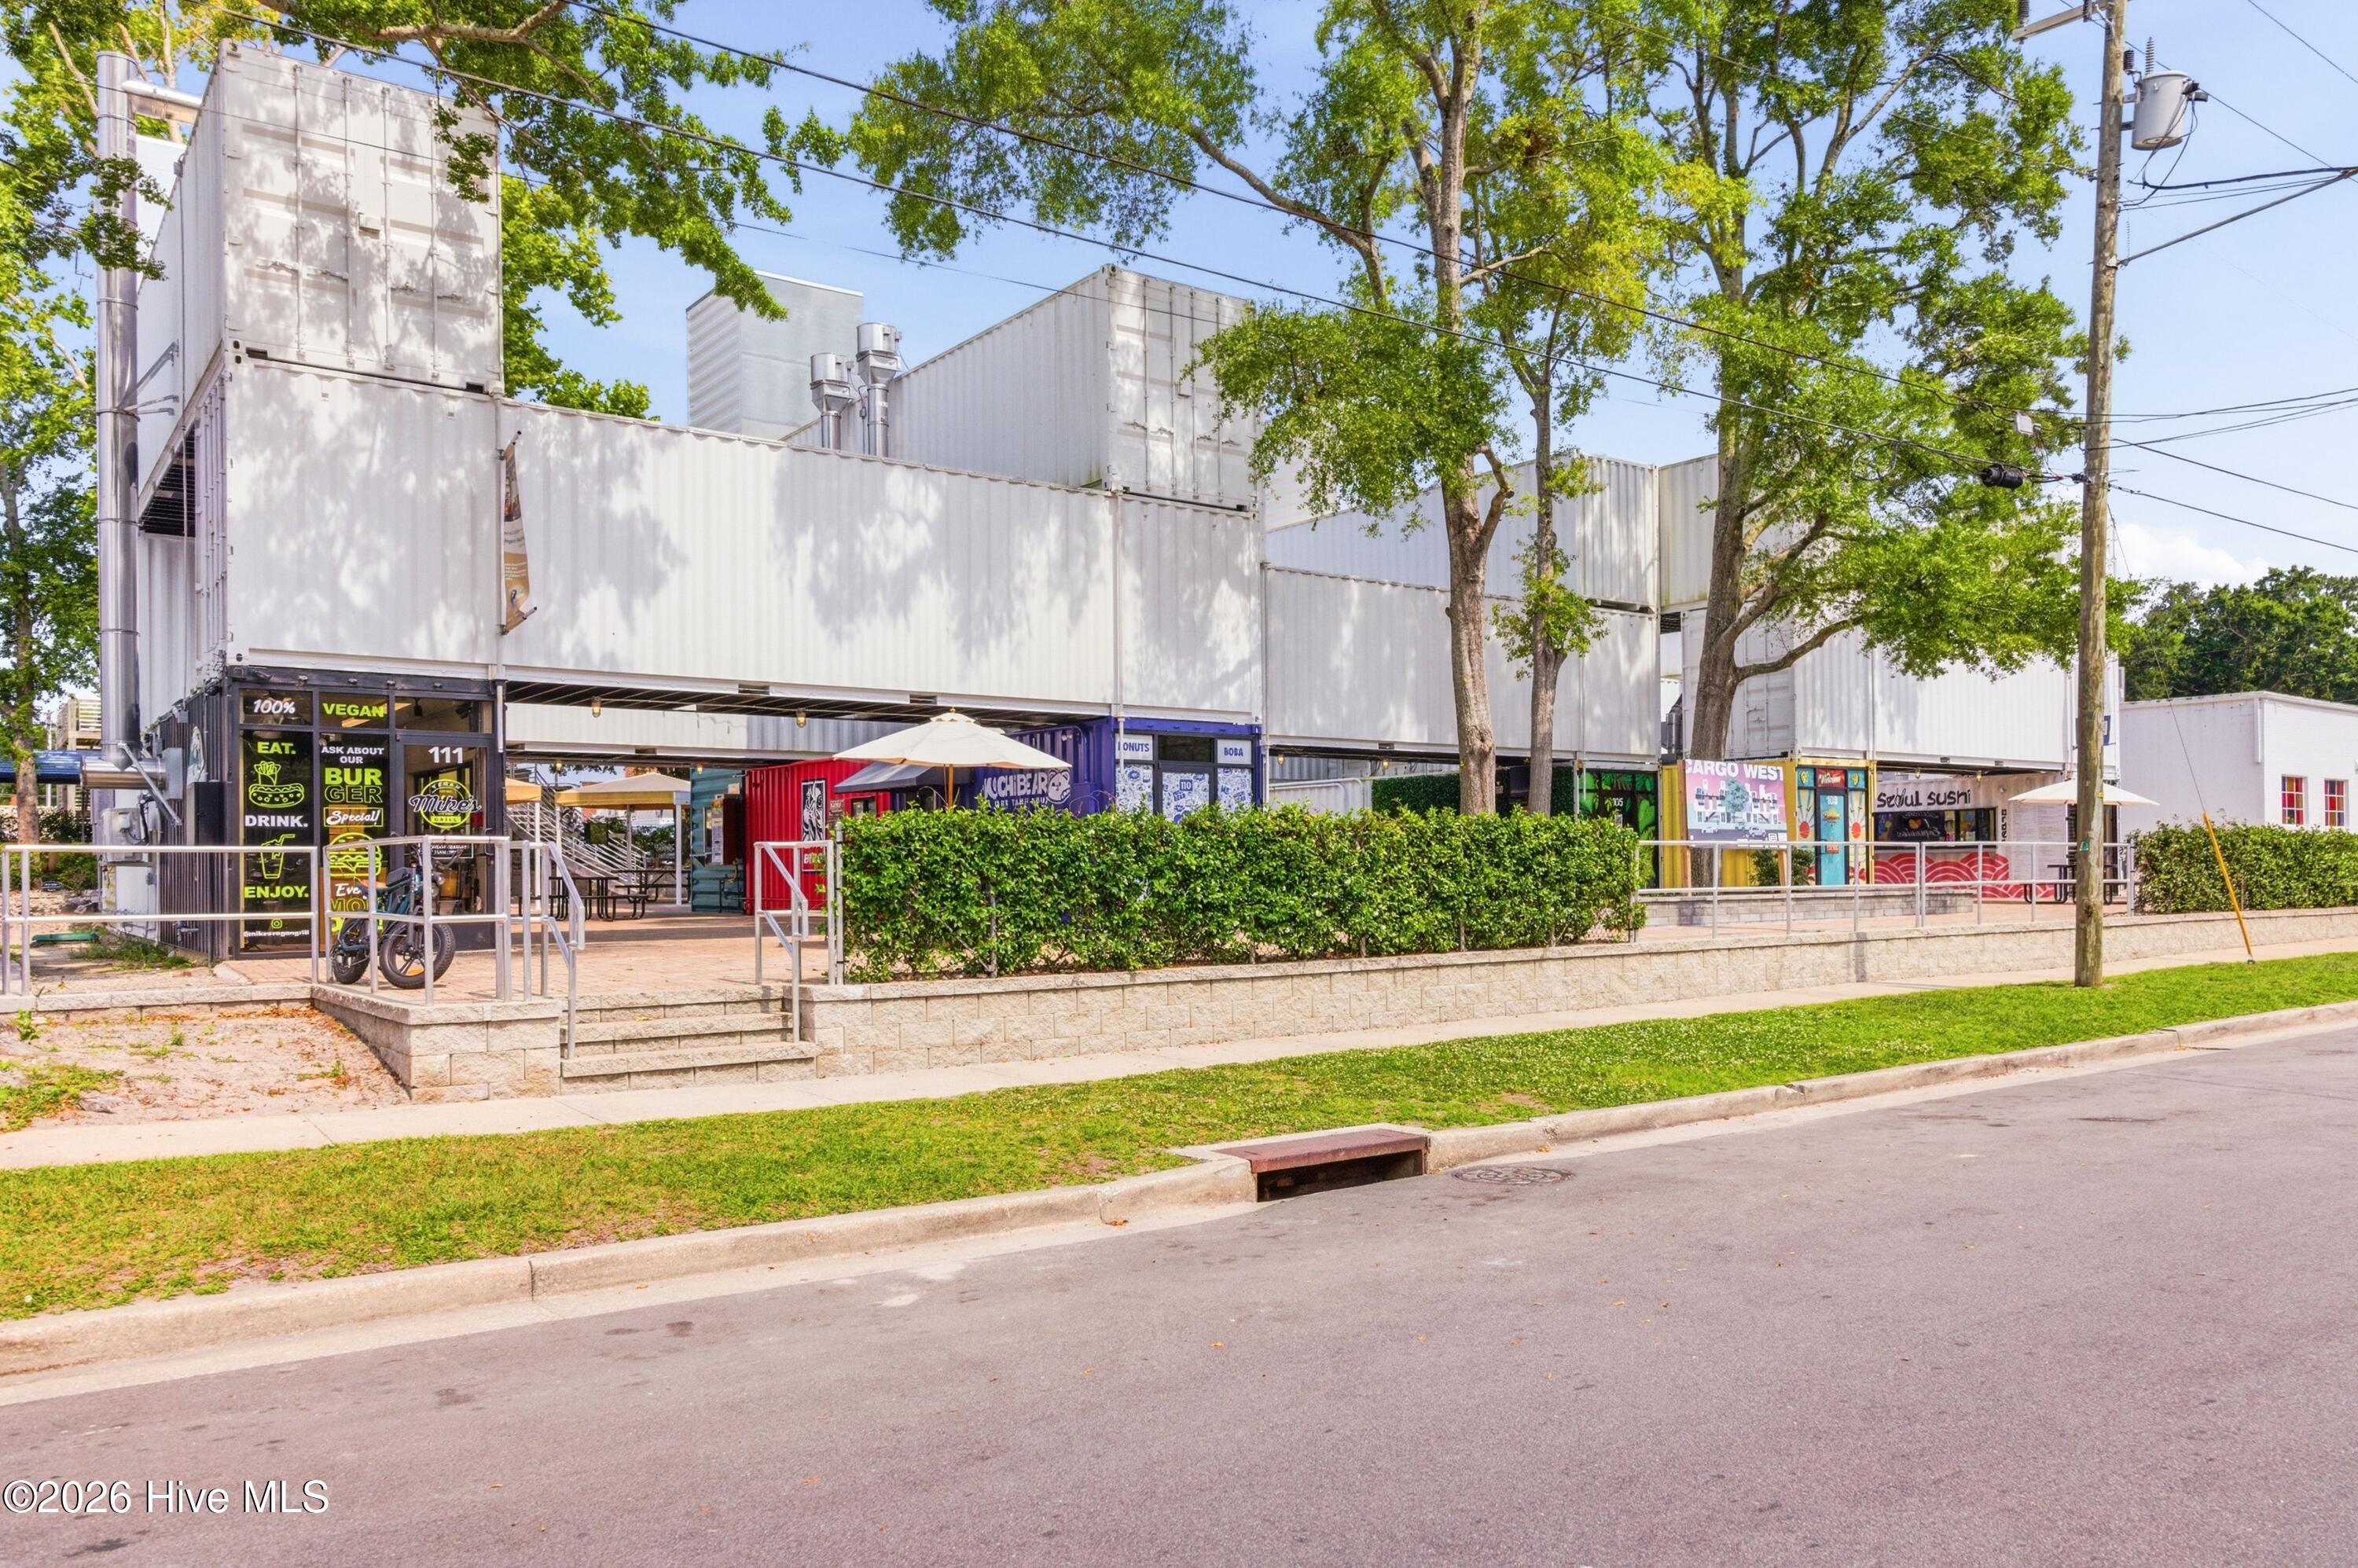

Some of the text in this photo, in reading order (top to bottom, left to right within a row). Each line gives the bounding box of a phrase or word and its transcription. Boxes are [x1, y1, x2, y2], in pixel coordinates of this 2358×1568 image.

[253, 699, 384, 718] 100% VEGAN
[257, 741, 296, 755] EAT.
[428, 747, 463, 763] 111
[325, 767, 383, 785] BUR
[1685, 758, 1739, 777] CARGO
[324, 784, 383, 803] GER
[1181, 781, 1192, 790] 110
[409, 794, 482, 814] Mike's
[244, 815, 308, 827] DRINK.
[326, 809, 381, 826] Special!
[244, 885, 309, 898] ENJOY.
